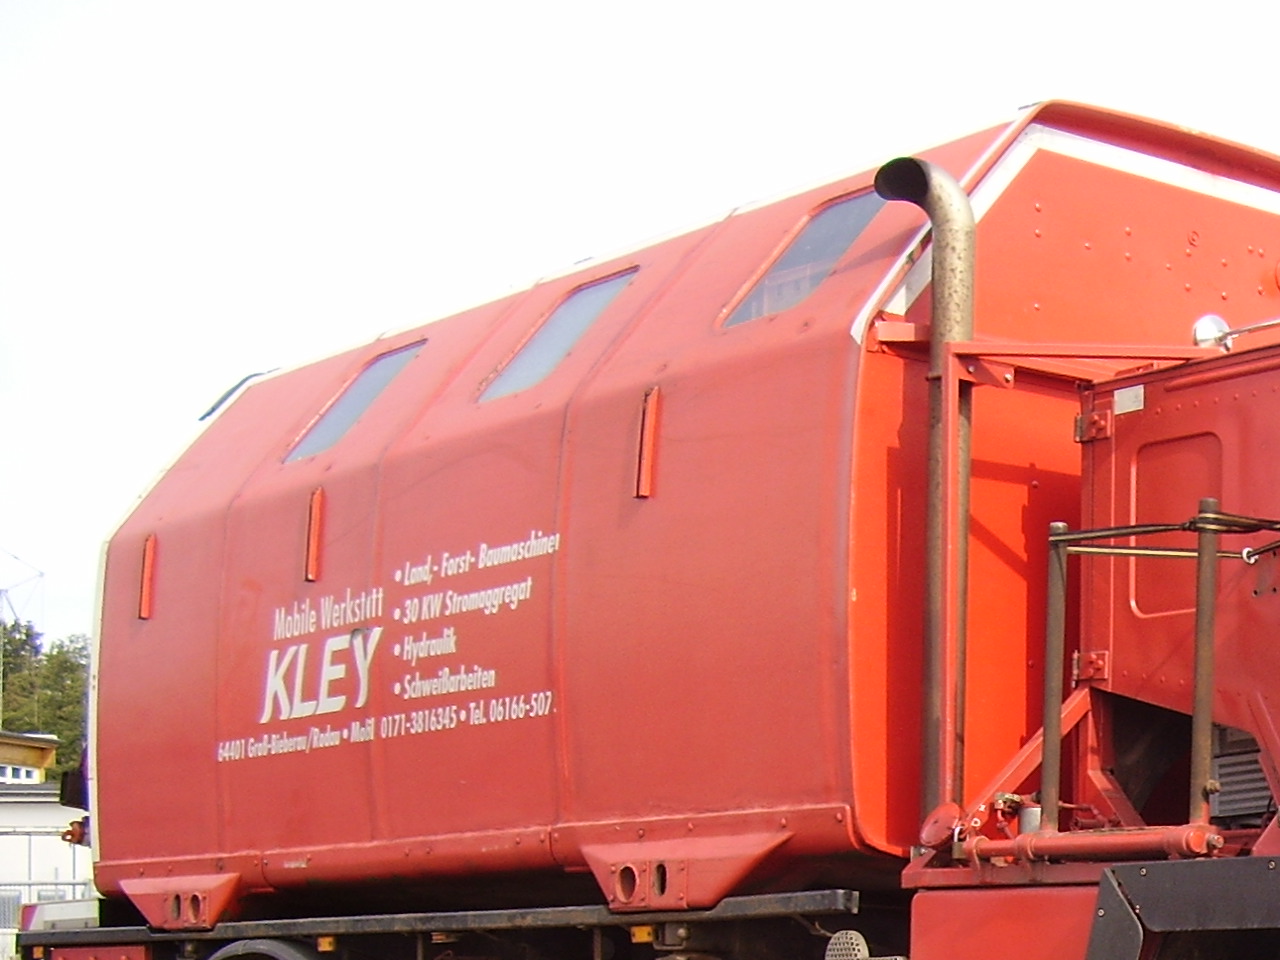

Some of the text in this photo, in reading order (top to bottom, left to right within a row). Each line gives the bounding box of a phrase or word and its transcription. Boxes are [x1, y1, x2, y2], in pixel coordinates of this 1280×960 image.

[274, 598, 317, 641] Mobile
[403, 577, 532, 624] 30 KW Stromaggregat
[403, 627, 457, 667] Hydraulik
[260, 627, 384, 724] KLEY
[403, 665, 496, 700] Schweißarbeiten
[217, 738, 245, 762] 64401
[380, 705, 458, 738] 0171-3816345
